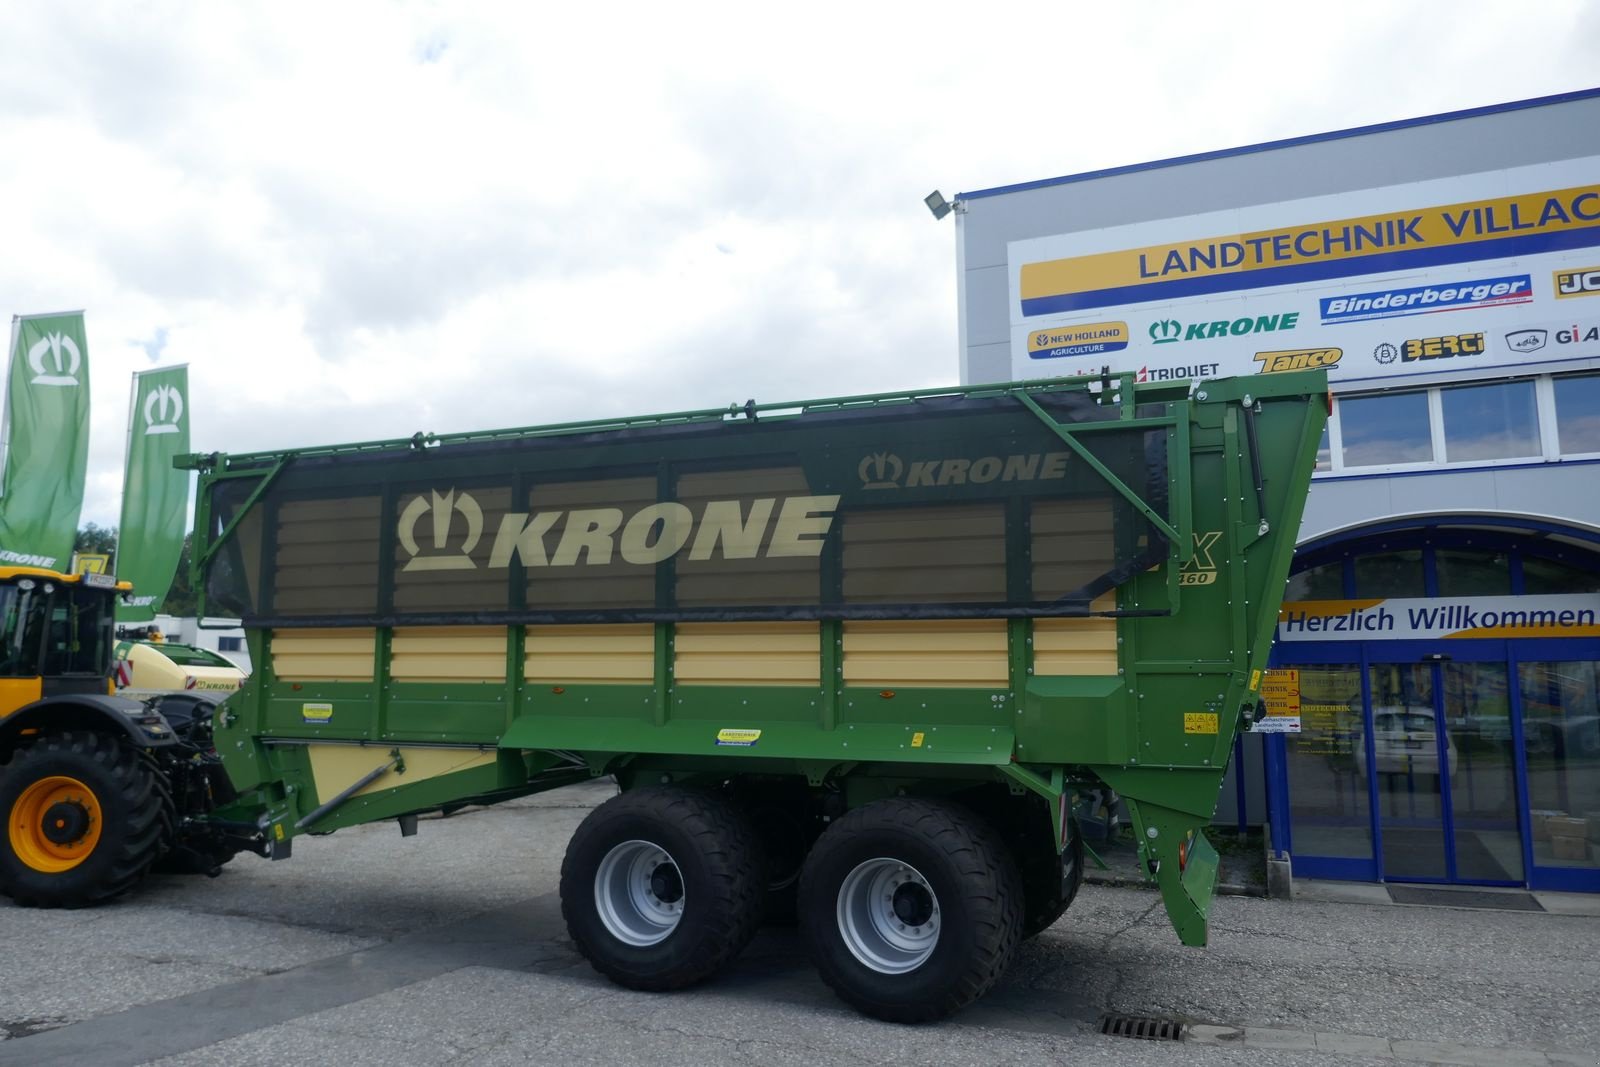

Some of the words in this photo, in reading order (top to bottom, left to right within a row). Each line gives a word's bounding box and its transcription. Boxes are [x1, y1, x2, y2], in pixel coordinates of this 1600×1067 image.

[1139, 217, 1424, 278] LANDTECHNIK
[1442, 193, 1600, 236] VILLAC
[1327, 280, 1525, 314] Binderberger
[1050, 333, 1072, 344] NEW
[1074, 329, 1120, 341] HOLLAND
[1185, 312, 1299, 340] KRONE
[1050, 344, 1104, 357] AGRICULTURE
[1253, 347, 1343, 373] Tanco
[1148, 363, 1219, 381] TRIOLIET
[905, 452, 1071, 488] KRONE
[488, 494, 841, 569] KRONE
[1180, 531, 1224, 570] X
[1286, 607, 1395, 633] Herzlich
[1408, 605, 1596, 630] Willkommen
